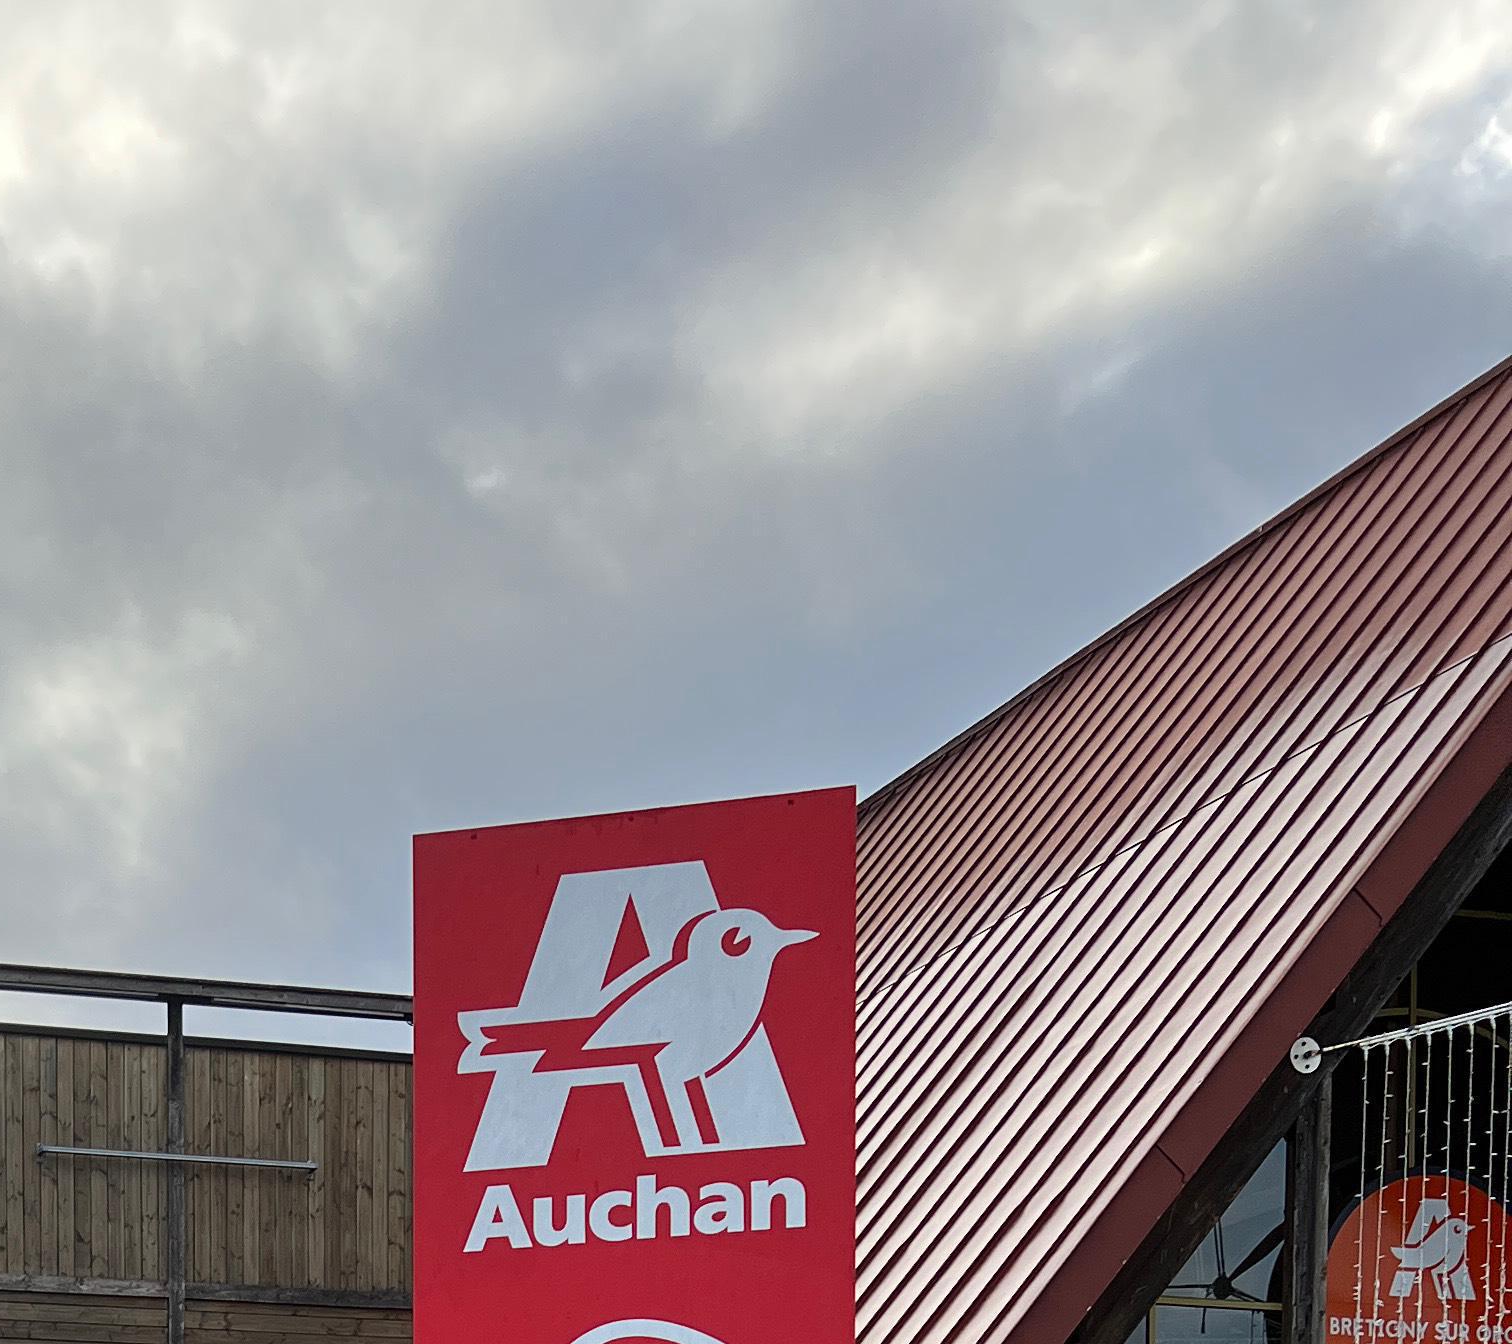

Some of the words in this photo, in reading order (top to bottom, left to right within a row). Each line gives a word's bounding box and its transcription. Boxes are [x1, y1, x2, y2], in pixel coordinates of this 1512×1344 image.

[462, 1173, 807, 1253] Auchan
[1329, 1316, 1429, 1340] BRETIGNY
[1434, 1322, 1470, 1342] SUR
